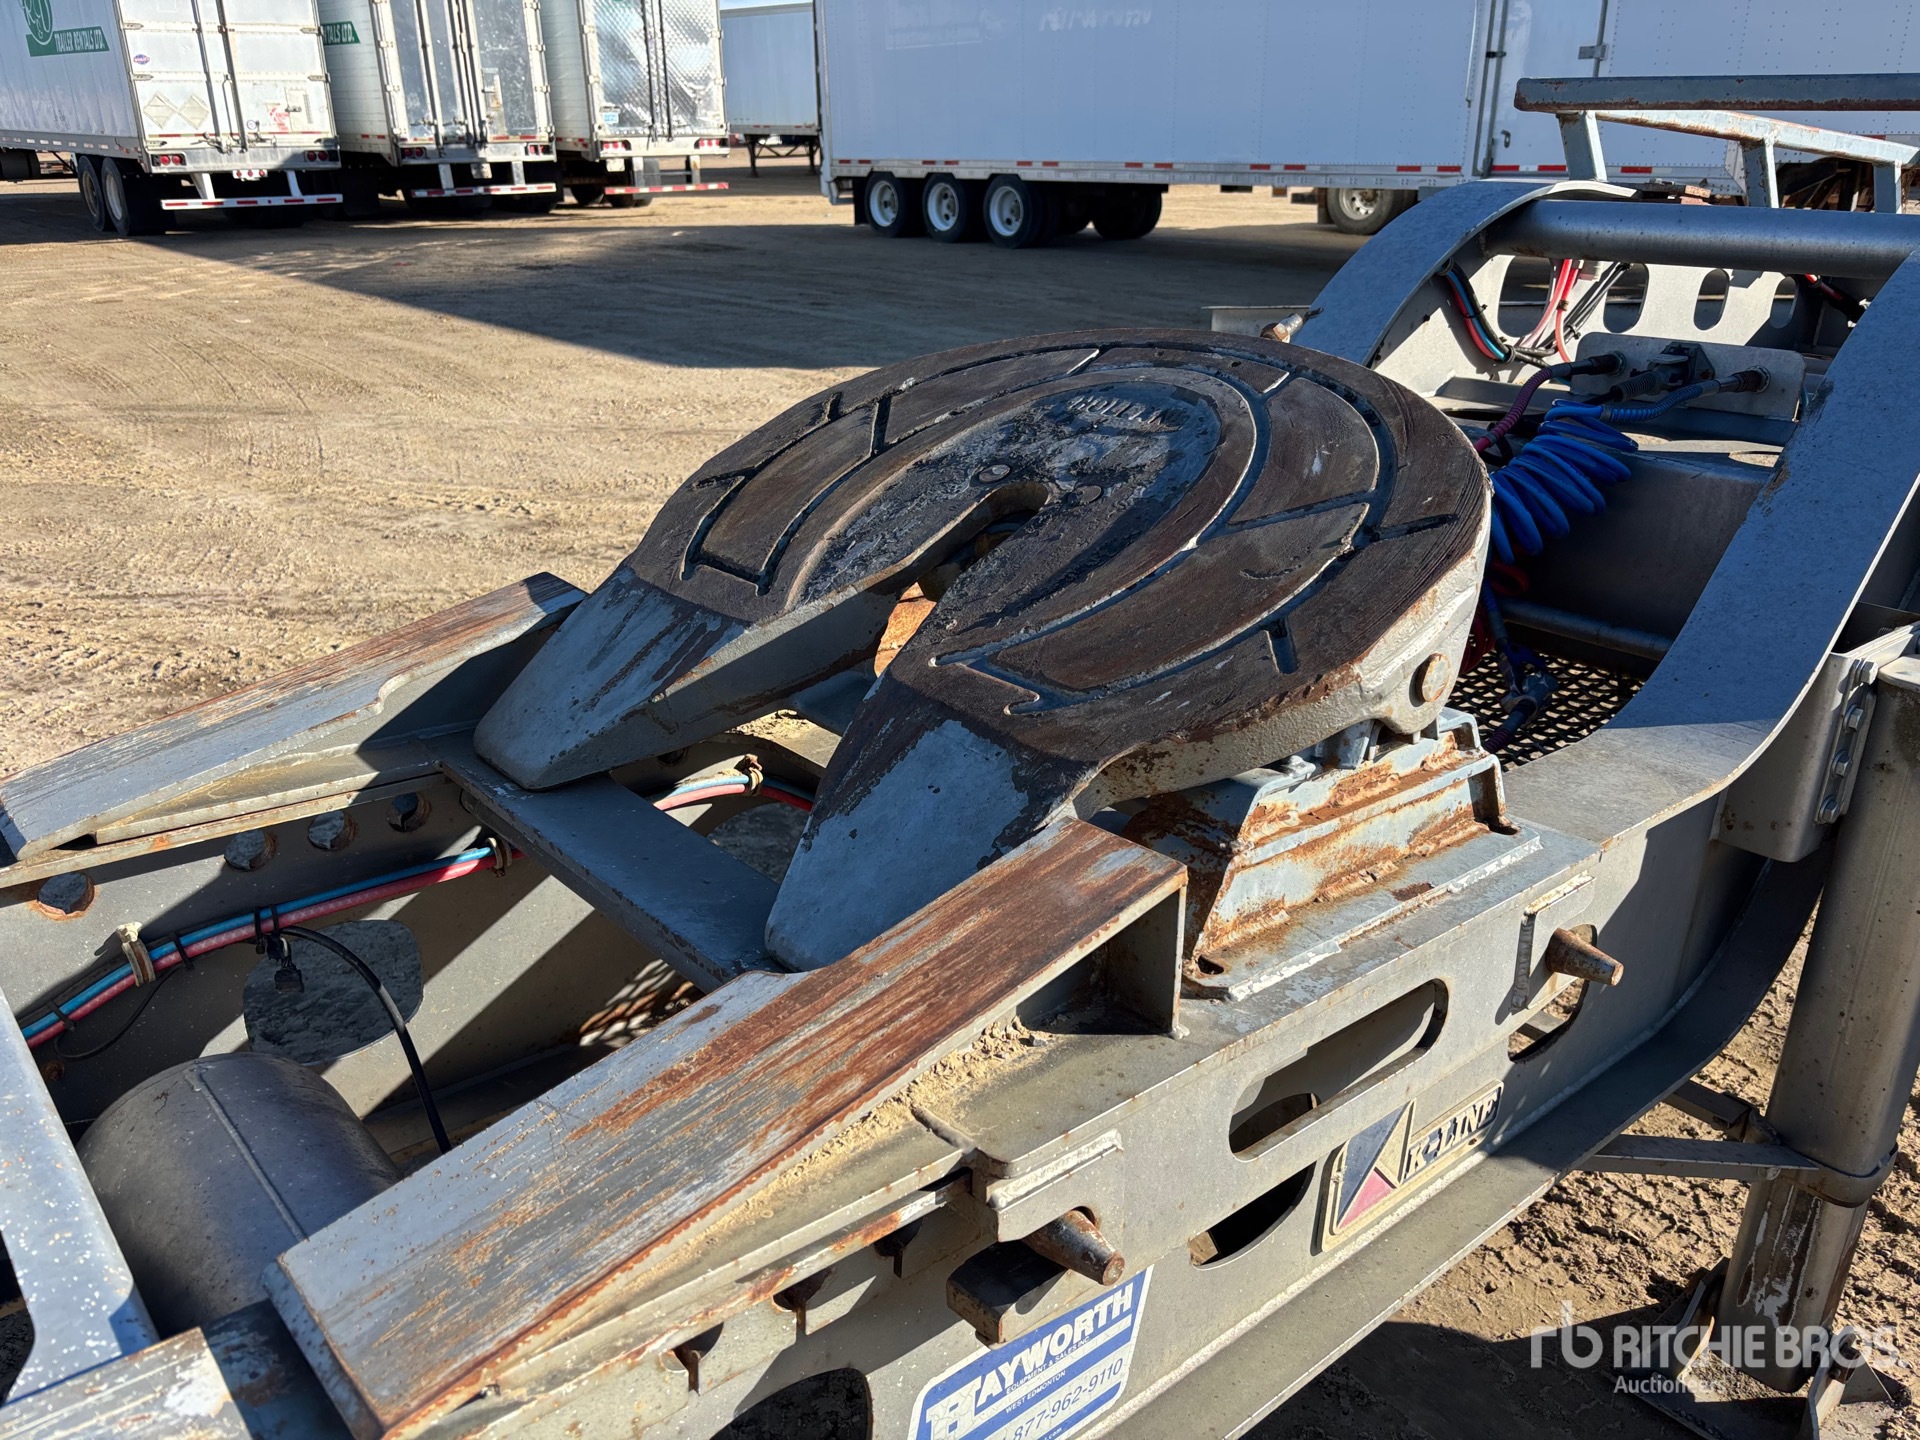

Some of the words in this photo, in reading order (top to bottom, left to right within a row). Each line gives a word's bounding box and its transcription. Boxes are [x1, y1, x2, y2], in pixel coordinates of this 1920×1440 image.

[54, 31, 74, 52] TRAILER
[73, 30, 94, 51] RENTALS
[1406, 1091, 1498, 1180] K-LINE
[1005, 1396, 1026, 1414] WEST
[1027, 1369, 1066, 1400] EDMONTON
[1006, 1363, 1048, 1395] EQUIPMENT
[1055, 1344, 1078, 1362] SALES
